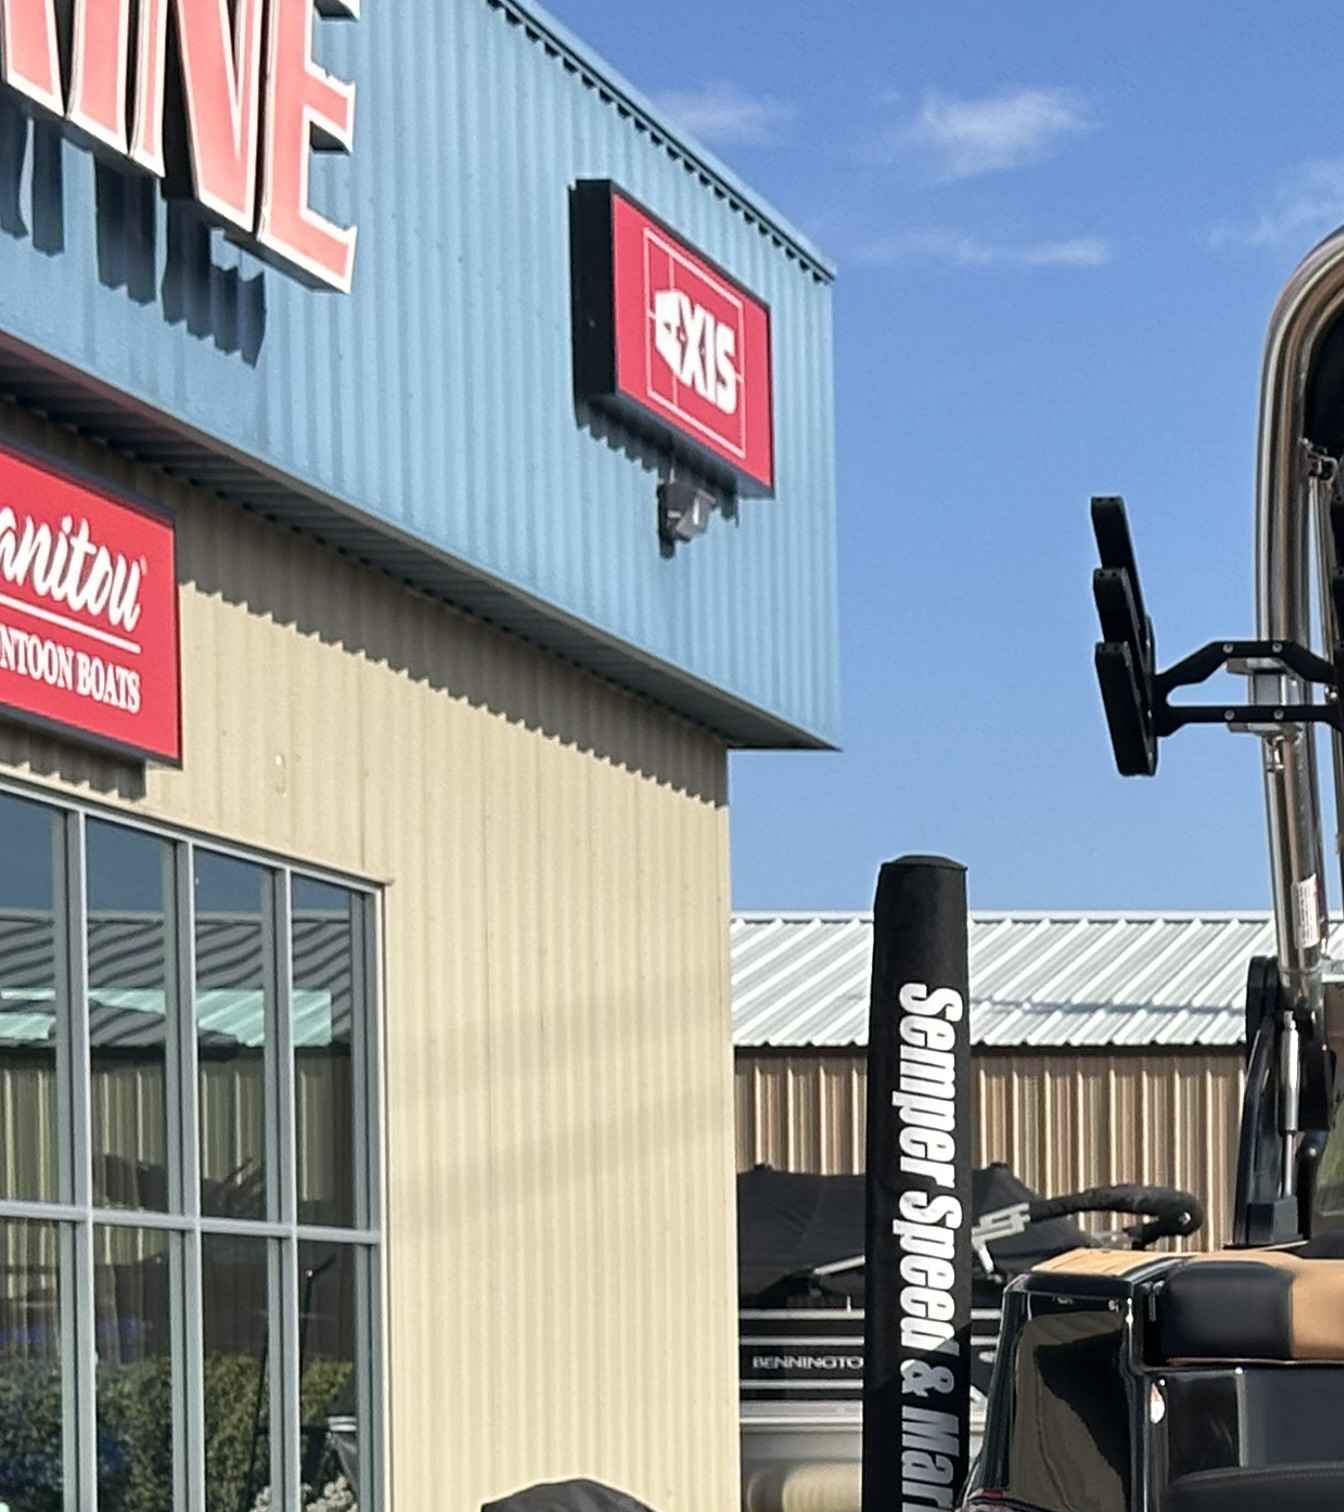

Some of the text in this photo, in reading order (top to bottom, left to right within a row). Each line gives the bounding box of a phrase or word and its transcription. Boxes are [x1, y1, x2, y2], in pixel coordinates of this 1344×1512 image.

[76, 652, 141, 714] BOATS
[892, 983, 962, 1189] Semper
[892, 1191, 962, 1356] Speed
[900, 1359, 955, 1397] &
